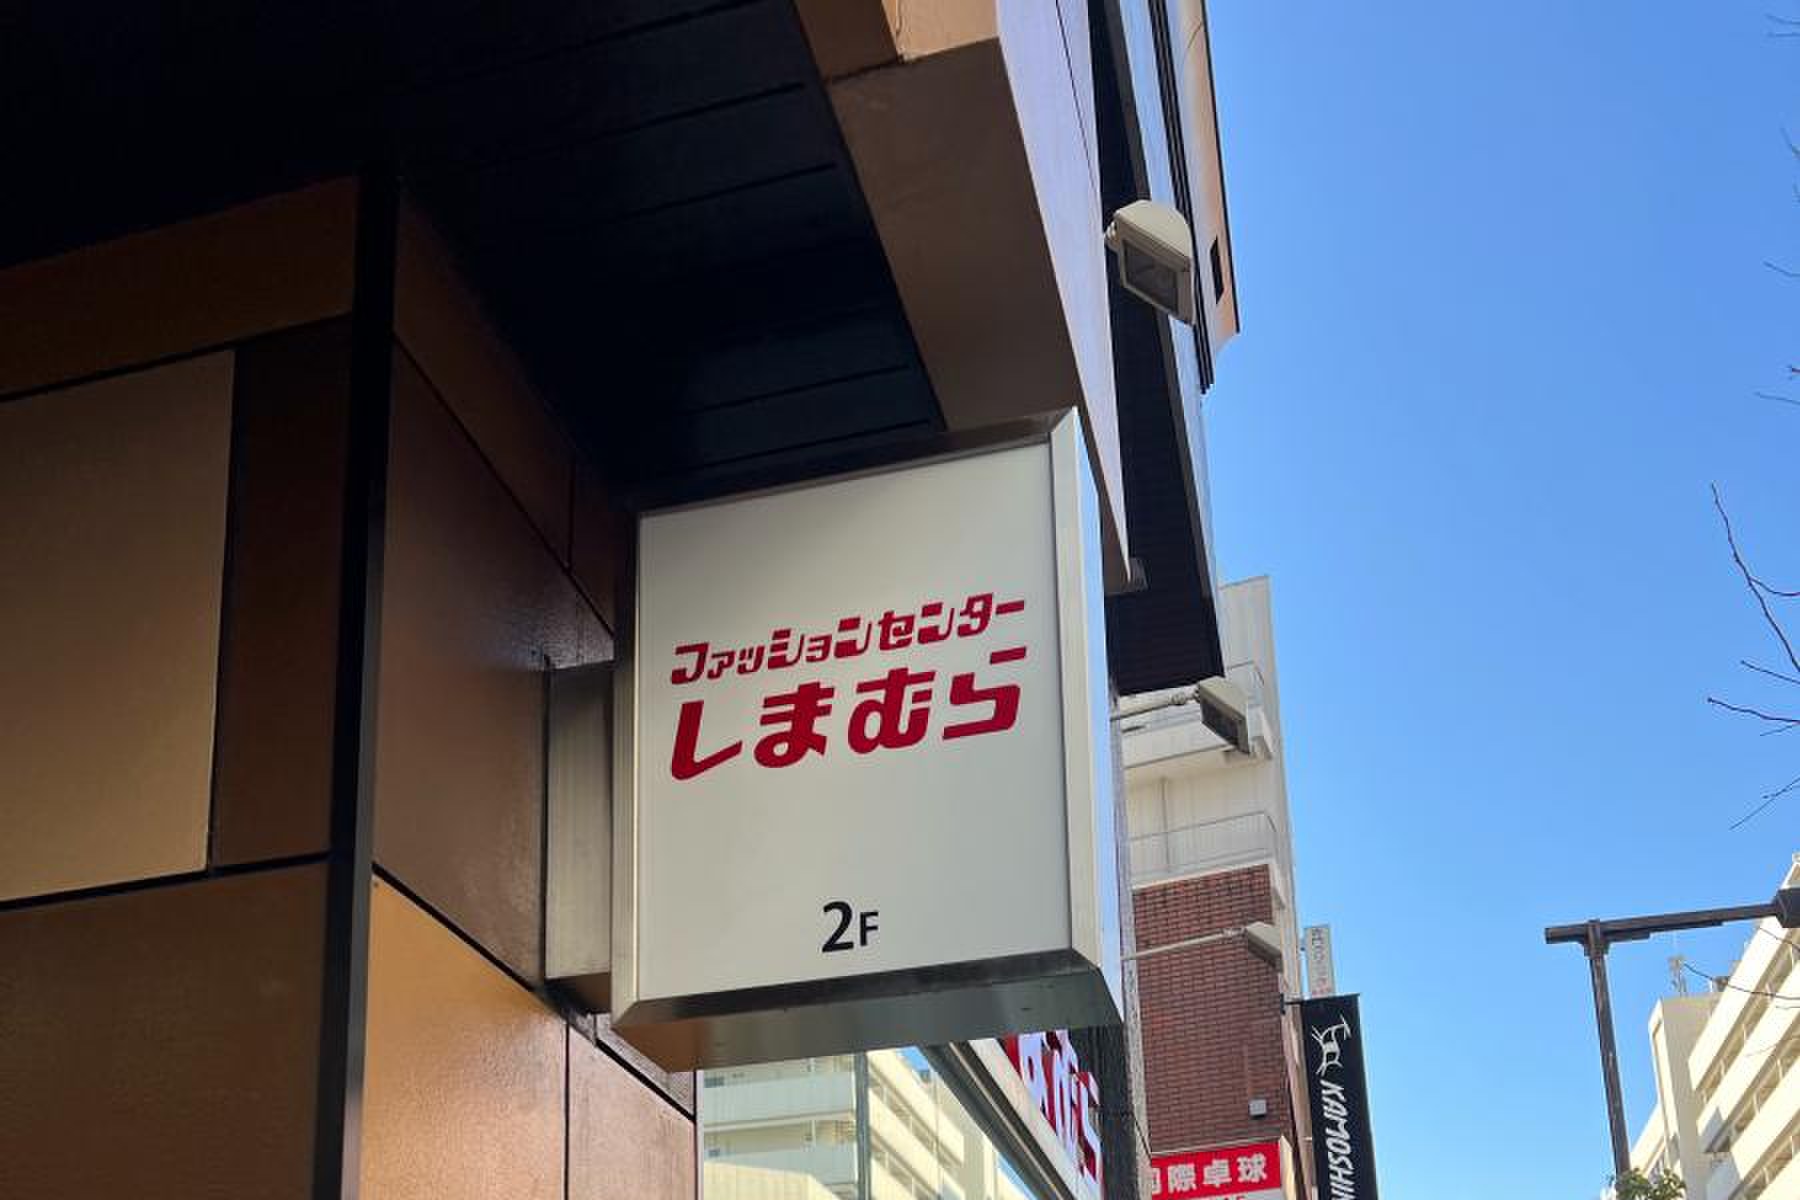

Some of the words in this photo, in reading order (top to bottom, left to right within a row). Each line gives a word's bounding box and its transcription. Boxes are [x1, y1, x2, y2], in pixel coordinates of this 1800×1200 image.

[671, 593, 1025, 685] ファッションセンター
[671, 646, 1027, 780] しまむら
[821, 901, 879, 952] 2F
